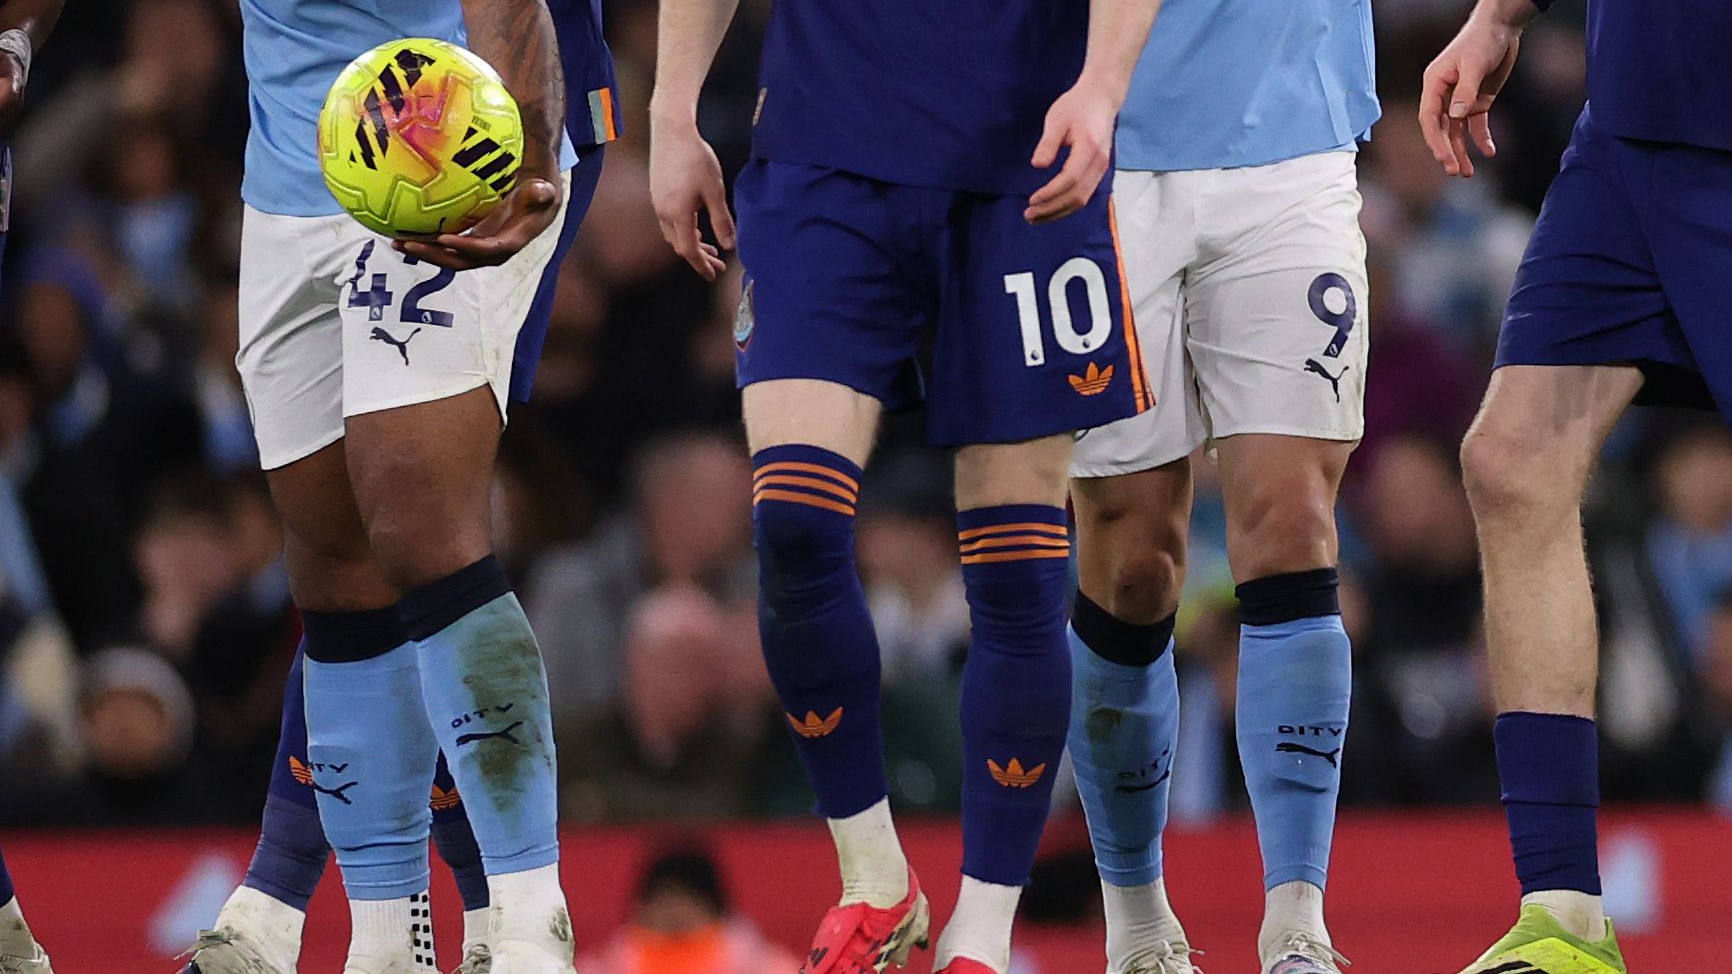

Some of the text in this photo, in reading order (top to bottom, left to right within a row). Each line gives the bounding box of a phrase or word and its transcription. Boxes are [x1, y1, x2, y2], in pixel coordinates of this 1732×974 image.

[348, 238, 457, 329] 42
[1003, 257, 1112, 367] 10
[1307, 272, 1357, 359] 9
